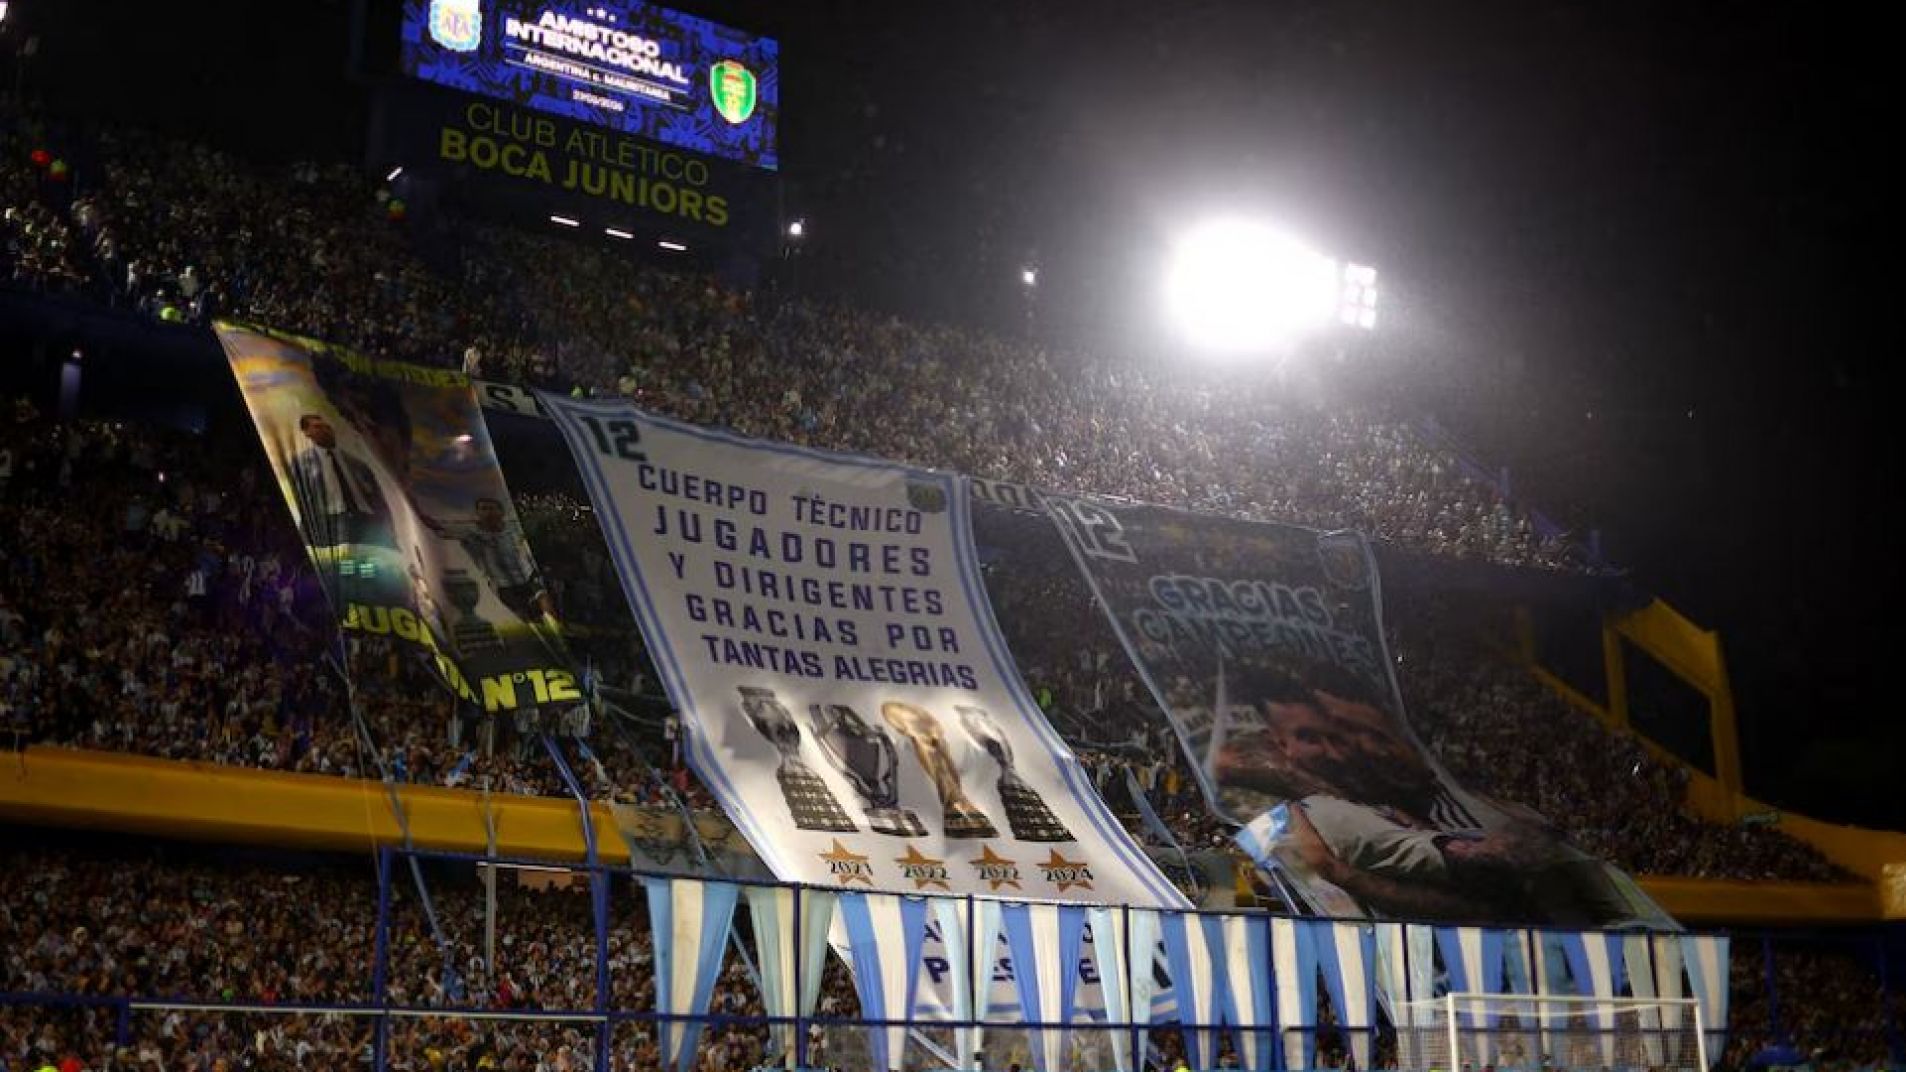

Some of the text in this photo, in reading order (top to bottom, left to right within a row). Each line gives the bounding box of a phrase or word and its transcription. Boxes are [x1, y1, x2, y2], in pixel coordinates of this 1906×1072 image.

[505, 17, 688, 84] INTERNACIONAL
[525, 52, 591, 79] ARGENTINA
[539, 10, 660, 57] AMISTOSO
[440, 126, 730, 227] BOCA JUNIORS
[466, 103, 709, 187] CLUB ATLÉTICO
[576, 415, 647, 462] 12
[637, 463, 769, 516] CUERPO
[792, 493, 922, 535] TÉCNICO
[653, 505, 931, 577] JUGADORES
[1054, 500, 1139, 566] 12
[668, 551, 944, 616] Y DIRIGENTES
[1149, 574, 1334, 629] GRACIAS
[685, 592, 959, 654] GRACIAS POR
[702, 634, 979, 691] TANTAS ALEGRIAS
